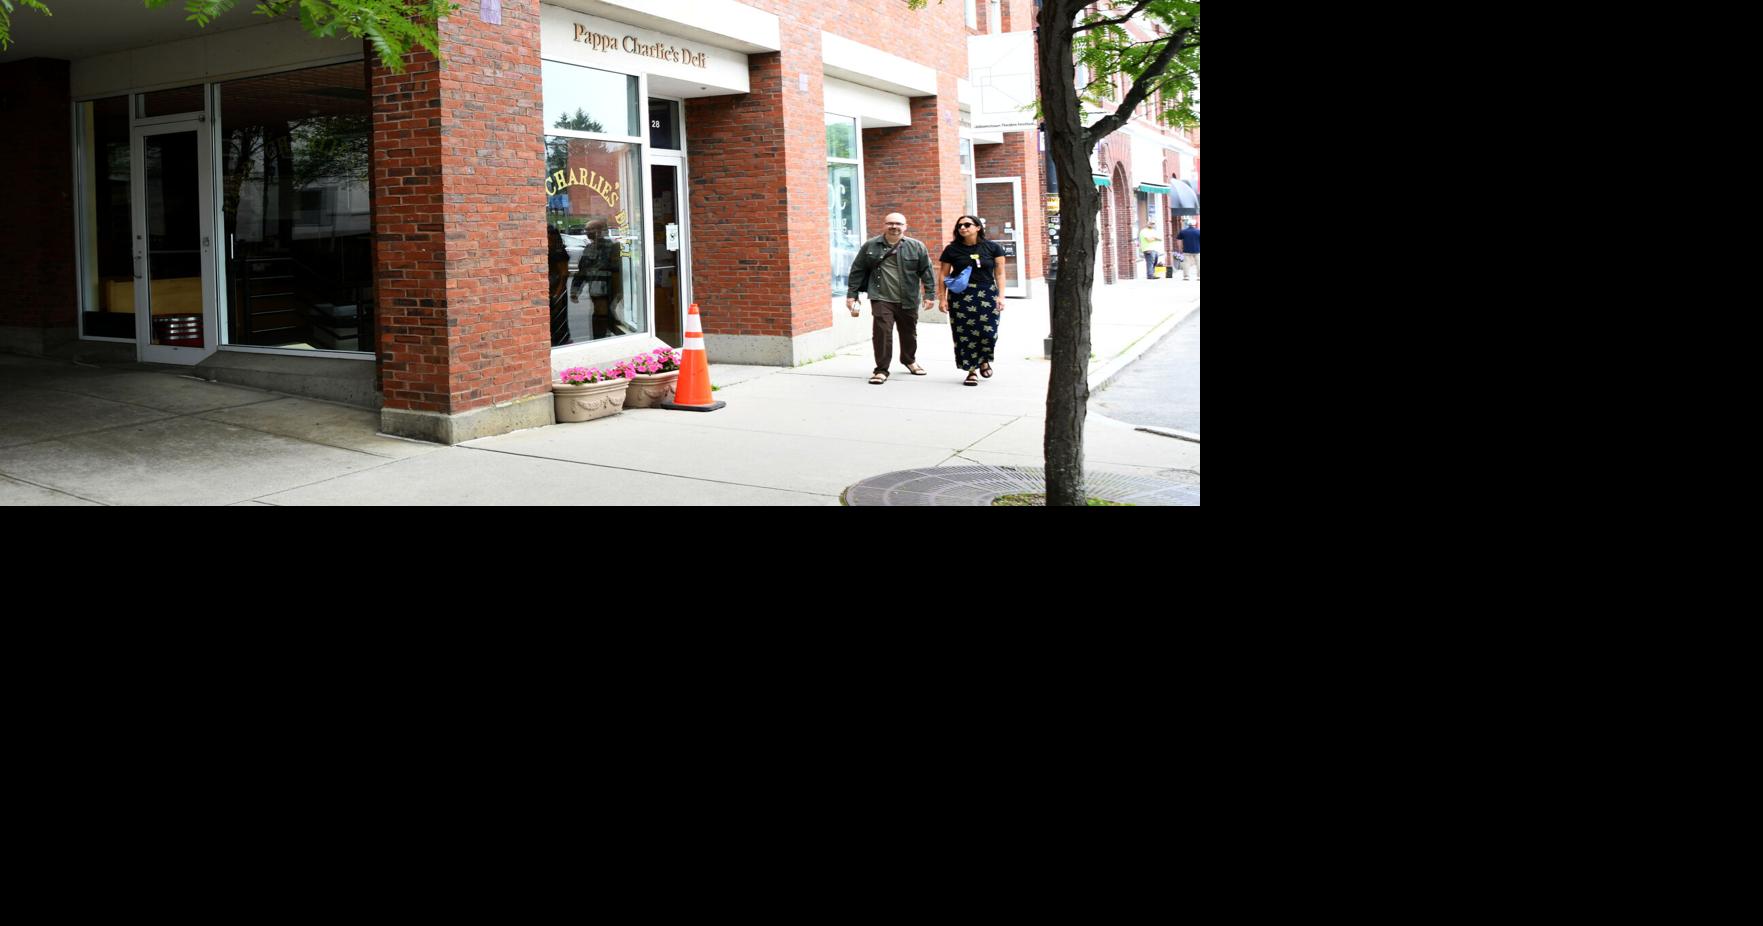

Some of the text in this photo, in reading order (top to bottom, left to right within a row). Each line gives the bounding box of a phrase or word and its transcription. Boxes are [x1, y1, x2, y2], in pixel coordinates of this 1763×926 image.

[573, 22, 708, 69] Pappa Charlie's Deli
[651, 120, 660, 128] 28
[544, 167, 620, 208] CHARLIE'S
